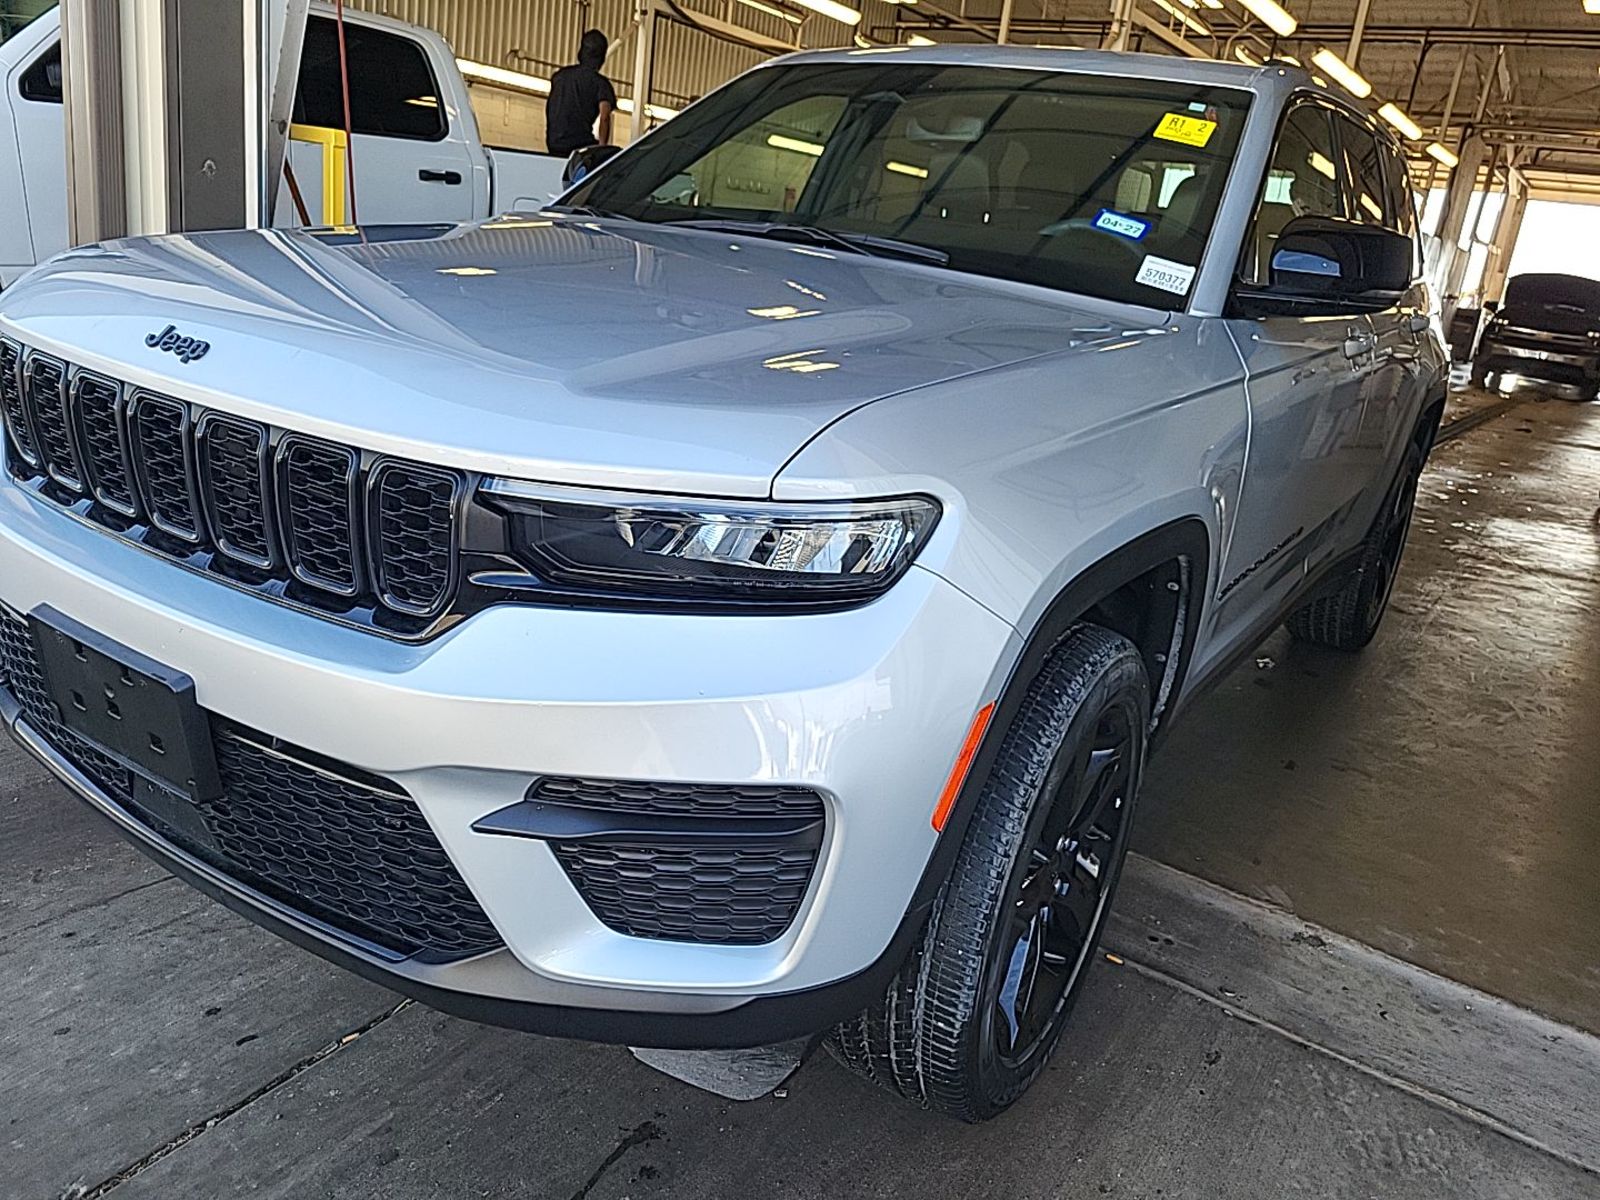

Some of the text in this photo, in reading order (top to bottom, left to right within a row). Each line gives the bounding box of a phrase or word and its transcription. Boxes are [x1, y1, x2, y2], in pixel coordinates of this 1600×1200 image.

[1168, 117, 1186, 129] R1
[1198, 122, 1208, 133] 2
[1145, 267, 1187, 287] 570377
[144, 323, 211, 365] Jeep
